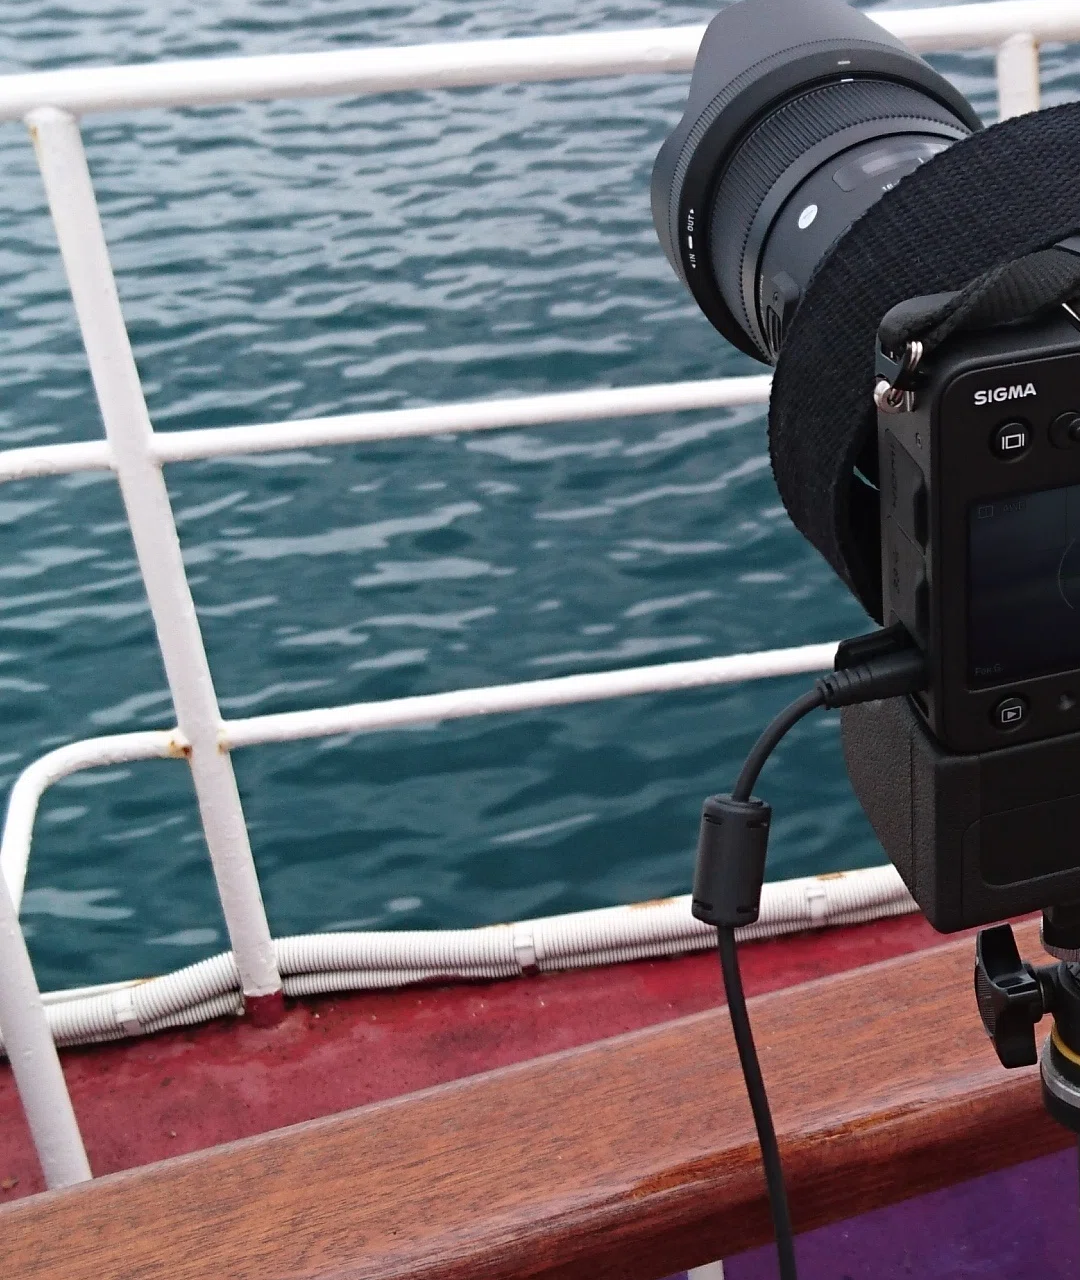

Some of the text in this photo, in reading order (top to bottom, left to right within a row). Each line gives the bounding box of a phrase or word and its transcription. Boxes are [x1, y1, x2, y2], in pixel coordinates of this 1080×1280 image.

[687, 214, 695, 232] OUT
[689, 253, 696, 263] IN
[974, 382, 1037, 406] SIGMA
